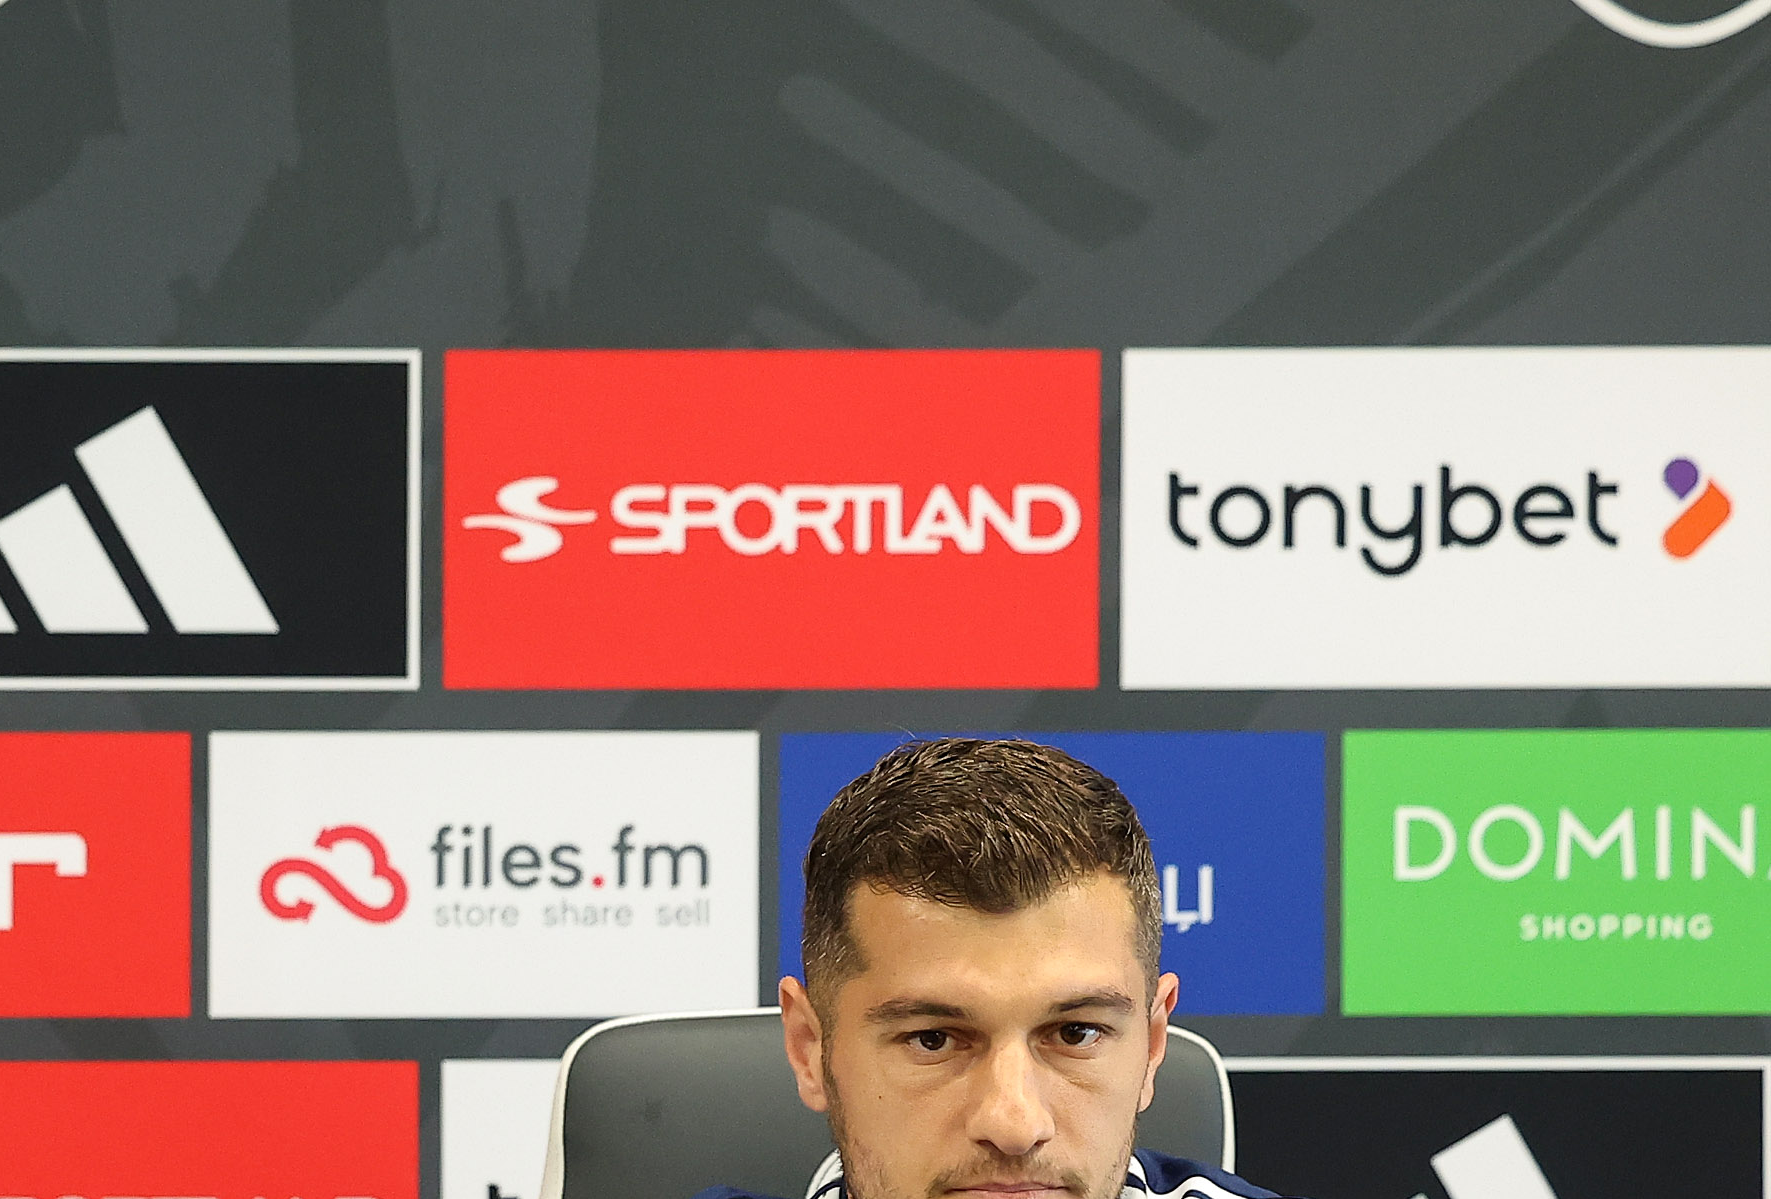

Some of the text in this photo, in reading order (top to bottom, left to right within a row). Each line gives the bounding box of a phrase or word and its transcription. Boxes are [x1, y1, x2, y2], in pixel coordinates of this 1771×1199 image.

[610, 483, 1082, 556] SPORTLAND
[1168, 464, 1619, 578] tonybet
[430, 824, 709, 889] files.fm
[1392, 804, 1771, 882] DOMIN
[434, 898, 711, 928] store share sell
[1519, 913, 1714, 941] SHOPPING
